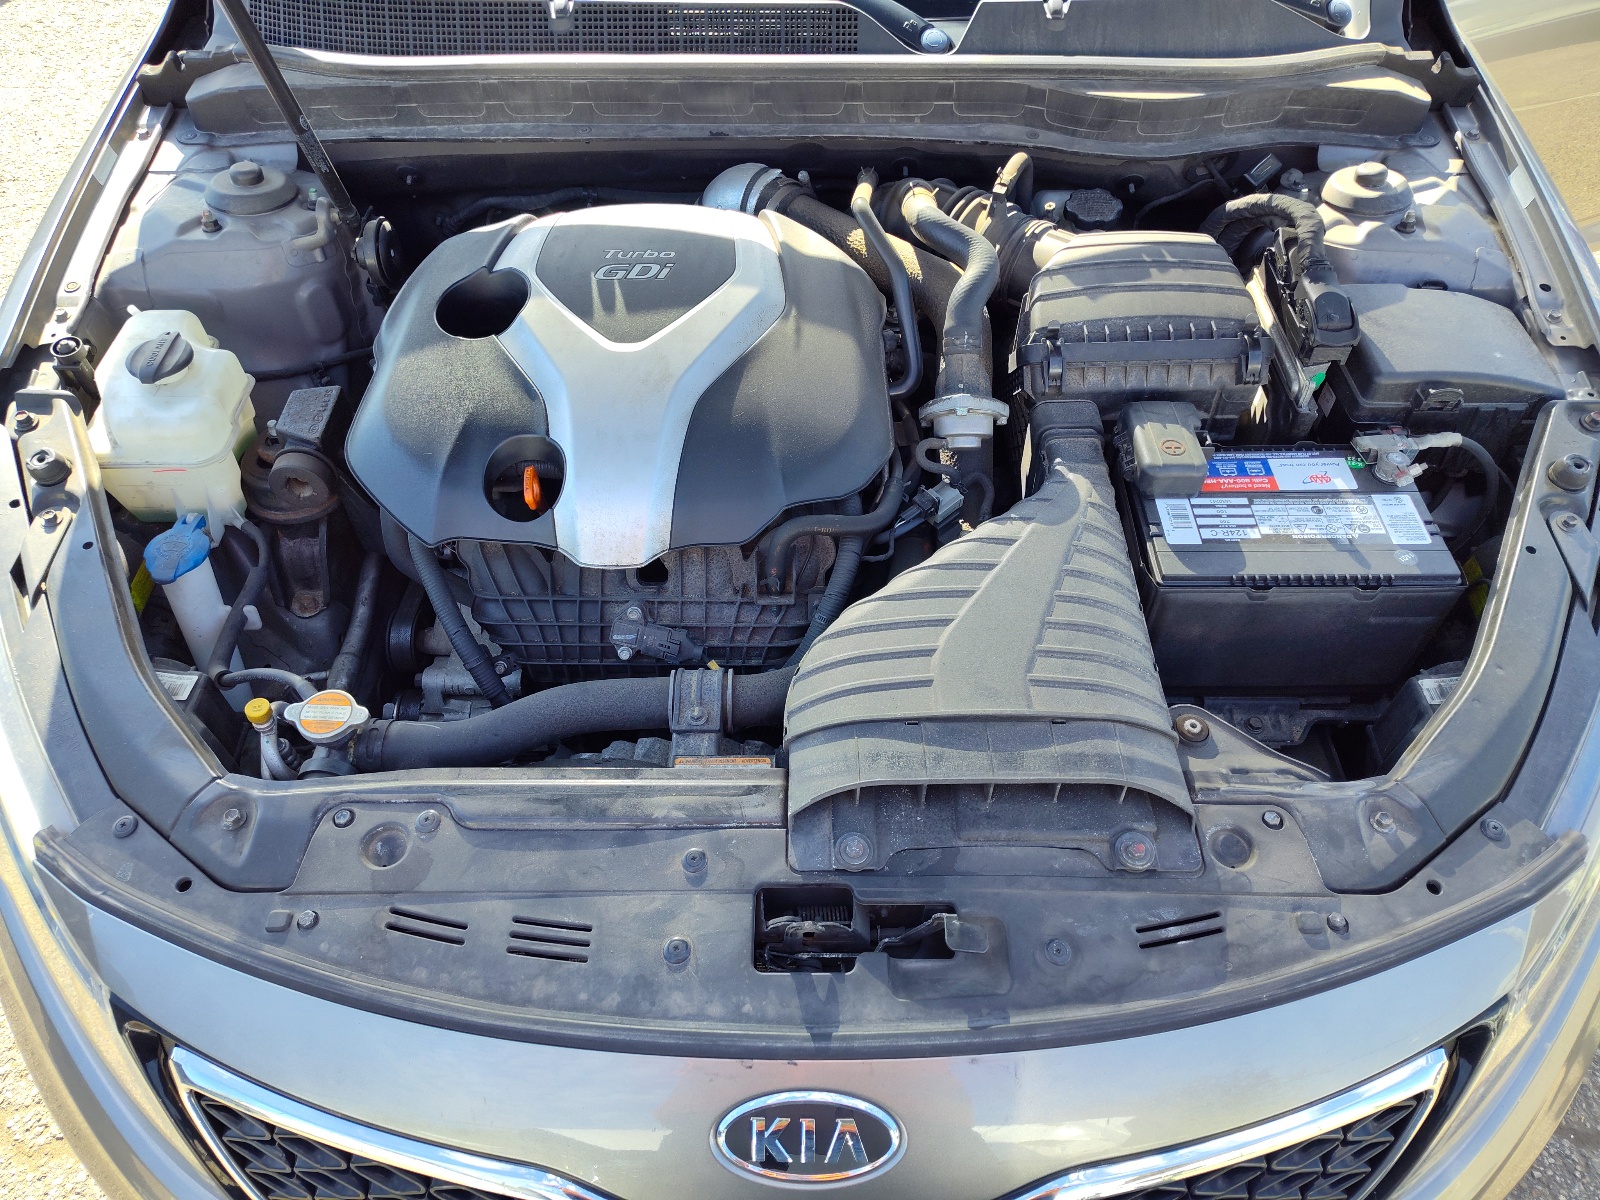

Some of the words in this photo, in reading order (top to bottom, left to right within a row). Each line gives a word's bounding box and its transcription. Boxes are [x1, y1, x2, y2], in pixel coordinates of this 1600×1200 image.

[603, 249, 676, 259] Turbo
[594, 263, 676, 280] GDi
[1310, 474, 1330, 484] AAA
[750, 1116, 869, 1164] KIA
